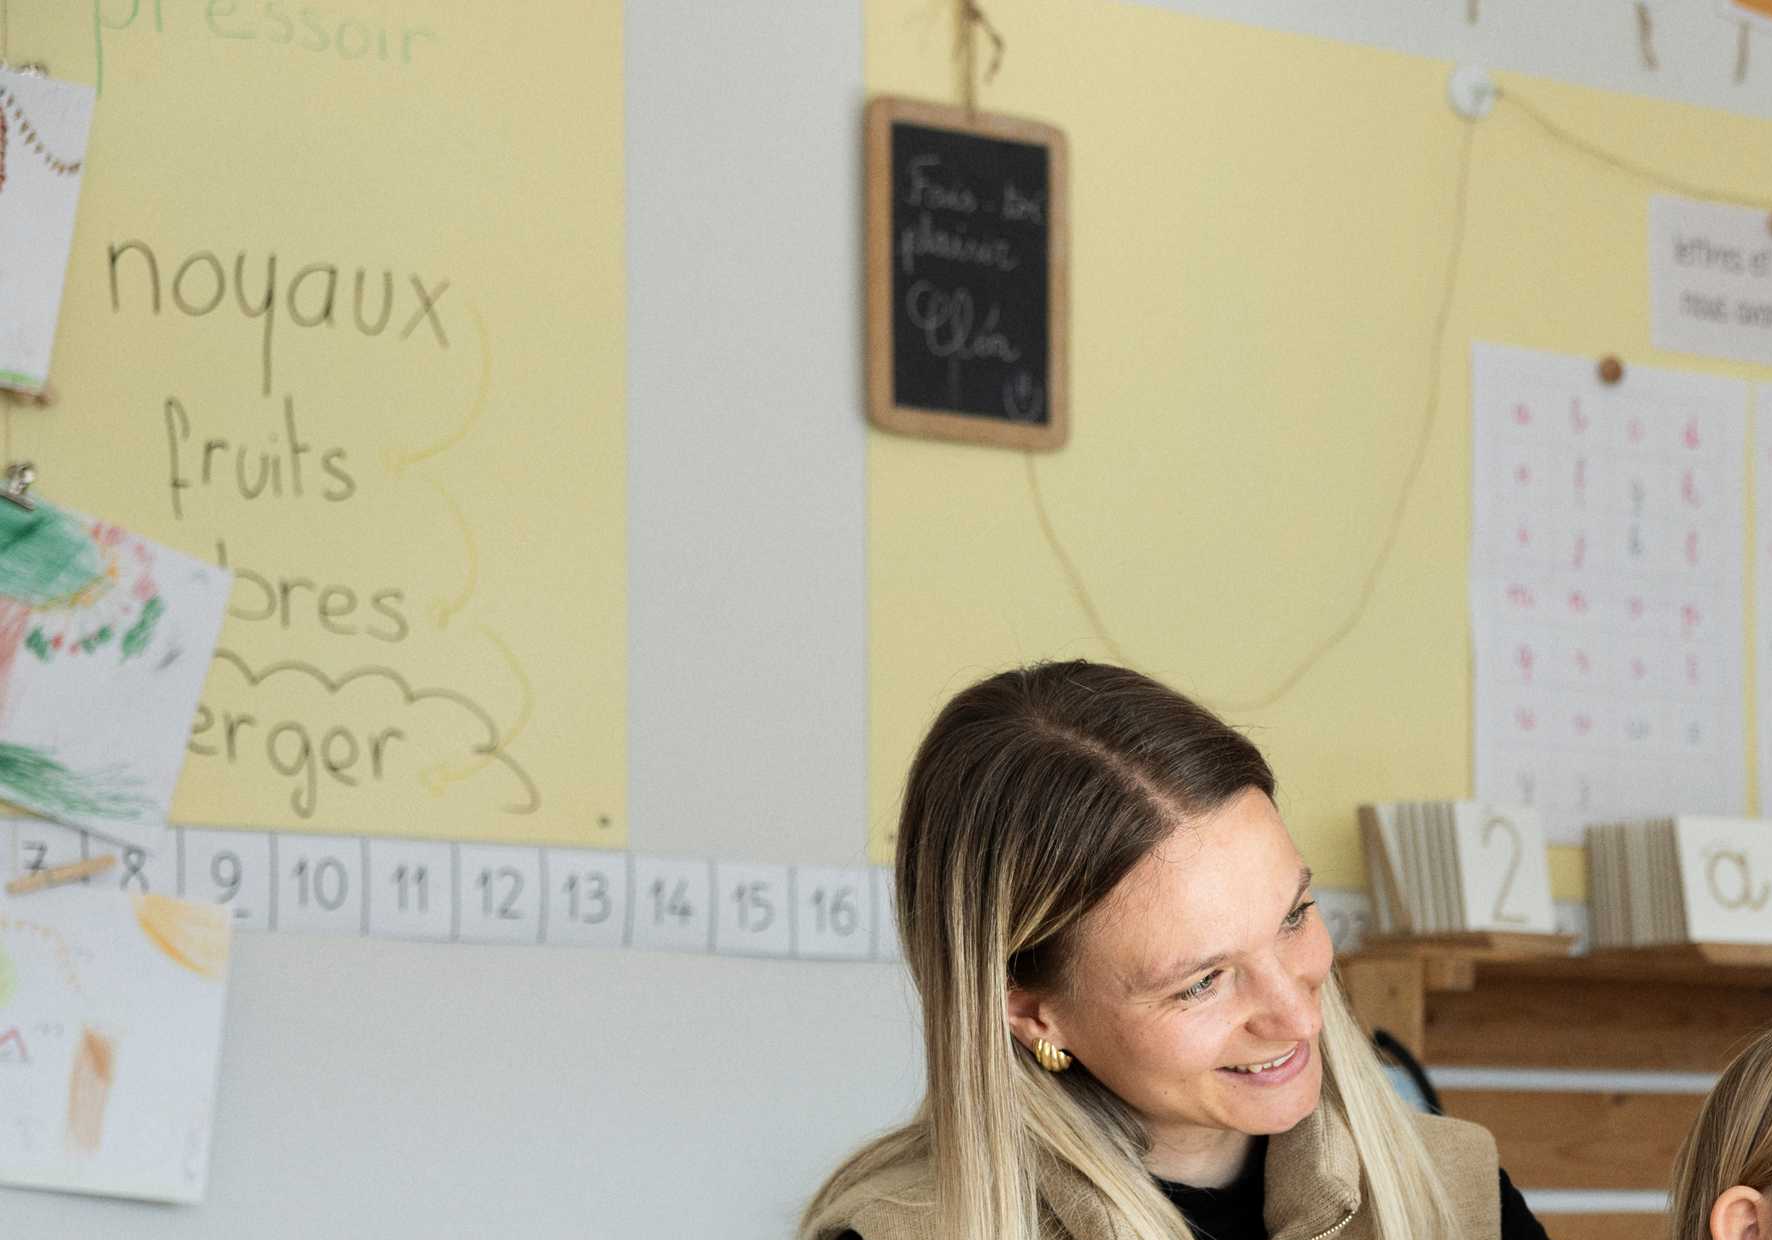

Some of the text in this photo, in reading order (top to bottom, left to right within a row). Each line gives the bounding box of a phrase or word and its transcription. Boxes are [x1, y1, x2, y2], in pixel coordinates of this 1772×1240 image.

[106, 237, 451, 396] noyaux
[163, 394, 358, 520] fruits
[210, 850, 243, 905] 9
[291, 856, 350, 911] 10
[391, 864, 431, 914] 11
[474, 866, 526, 920] 12
[562, 871, 614, 925] 13
[650, 876, 694, 927] 14
[731, 880, 776, 934] 15
[811, 885, 860, 937] 16
[1480, 814, 1528, 924] 2
[1705, 846, 1772, 914] a
